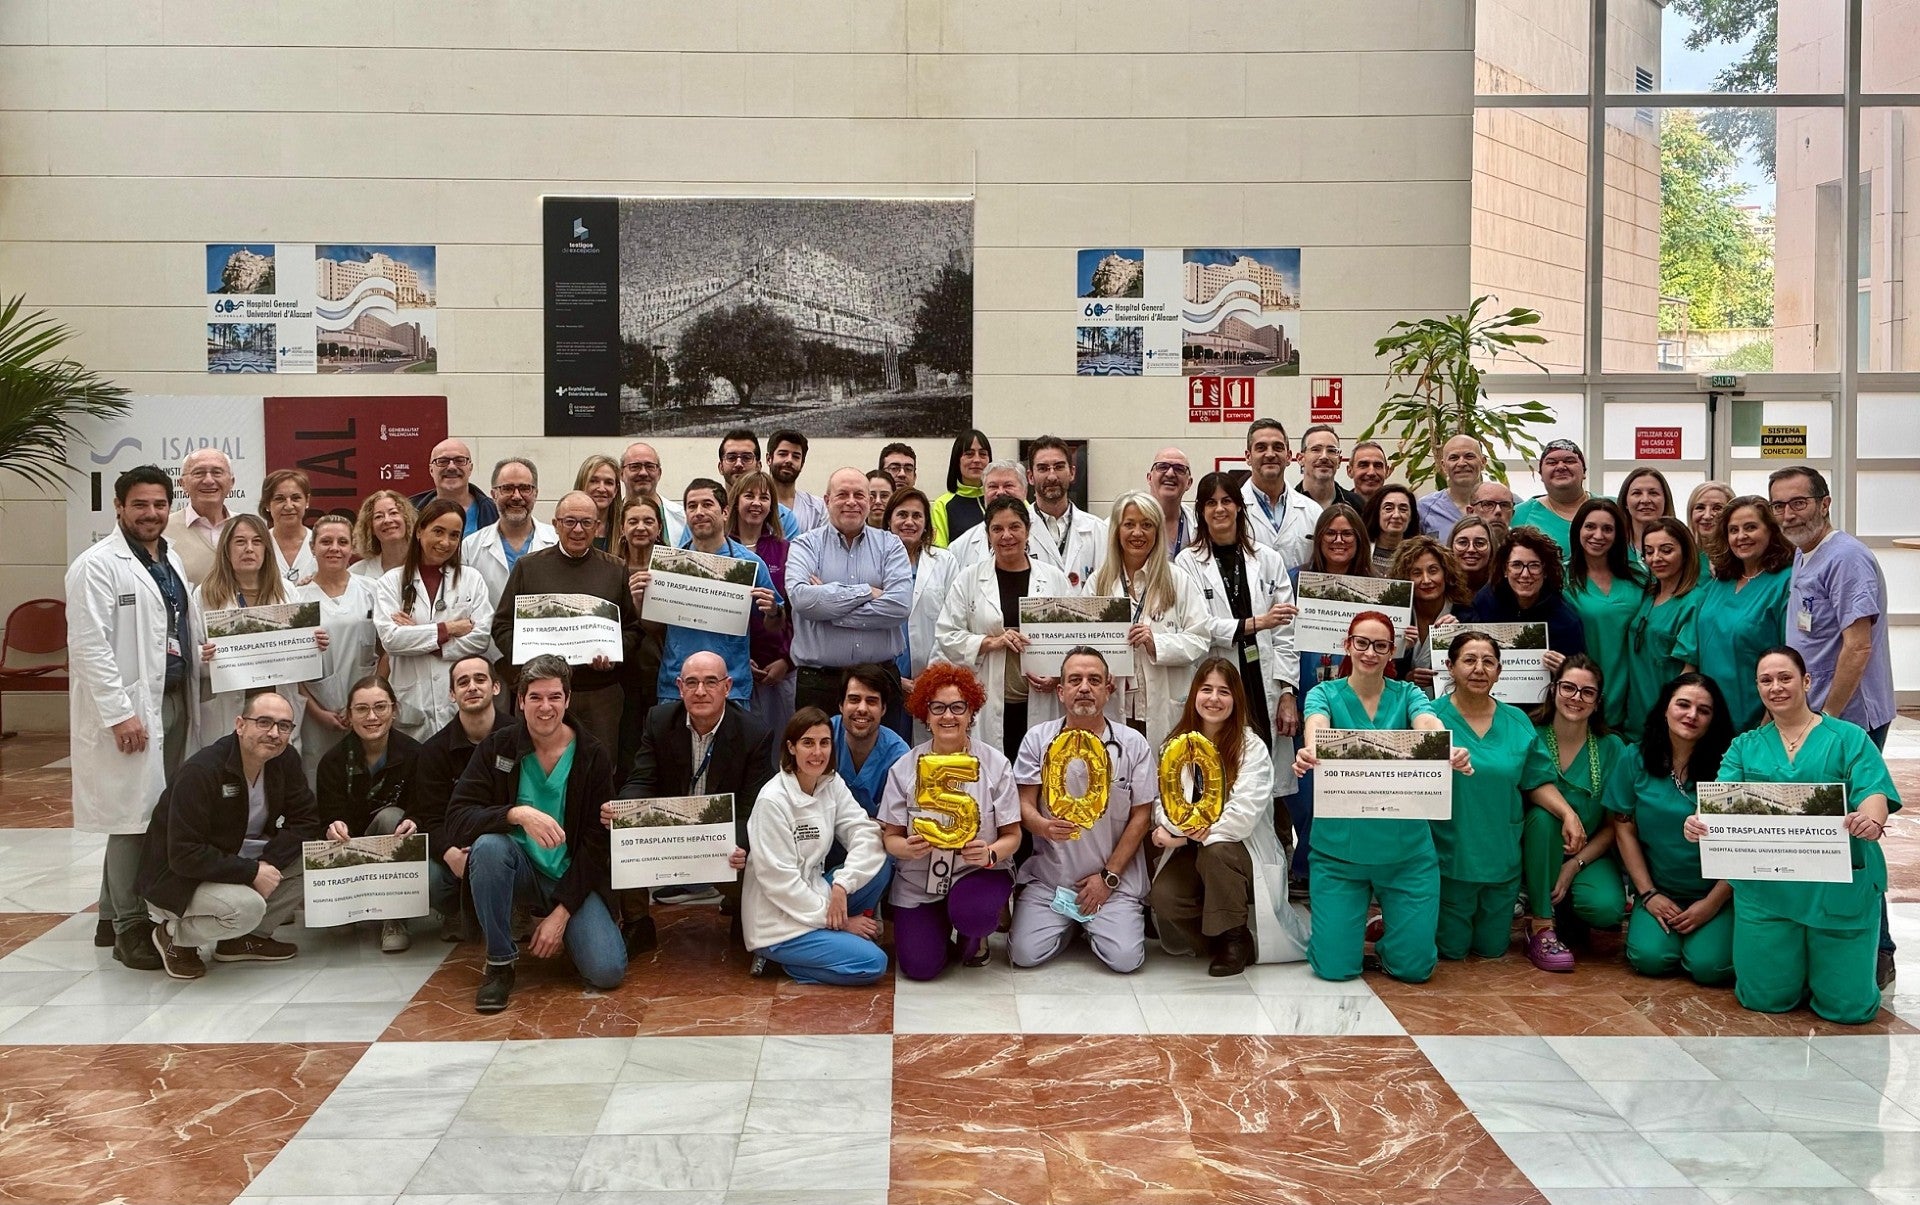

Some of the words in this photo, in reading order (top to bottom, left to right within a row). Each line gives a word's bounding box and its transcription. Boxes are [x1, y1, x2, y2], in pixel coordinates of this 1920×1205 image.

[246, 300, 272, 309] Hospital
[274, 300, 298, 308] General
[1115, 303, 1140, 312] Hospital
[1141, 303, 1166, 311] General
[246, 310, 282, 318] Universitari
[283, 310, 312, 318] d'Alacant
[1115, 313, 1150, 321] Universitari
[1712, 376, 1736, 387] SALIDA
[667, 581, 709, 595] TRASPLANTES
[710, 589, 744, 600] HEPÁTICOS
[580, 623, 615, 632] HEPÁTICOS
[1088, 631, 1125, 639] HEPÁTICOS
[230, 641, 277, 652] TRASPLANTES
[278, 637, 316, 646] HEPÁTICOS
[1502, 657, 1541, 665] HEPÁTICOS
[1339, 770, 1395, 778] TRASPLANTES
[1397, 769, 1442, 778] HEPÁTICOS
[1709, 826, 1725, 834] 500
[1727, 827, 1786, 835] TRASPLANTES
[1788, 826, 1838, 836] HEPÁTICOS
[635, 836, 685, 845] TRASPLANTES
[686, 834, 727, 842] HEPÁTICOS
[328, 874, 377, 886] TRASPLANTES
[379, 872, 419, 880] HEPÁTICOS
